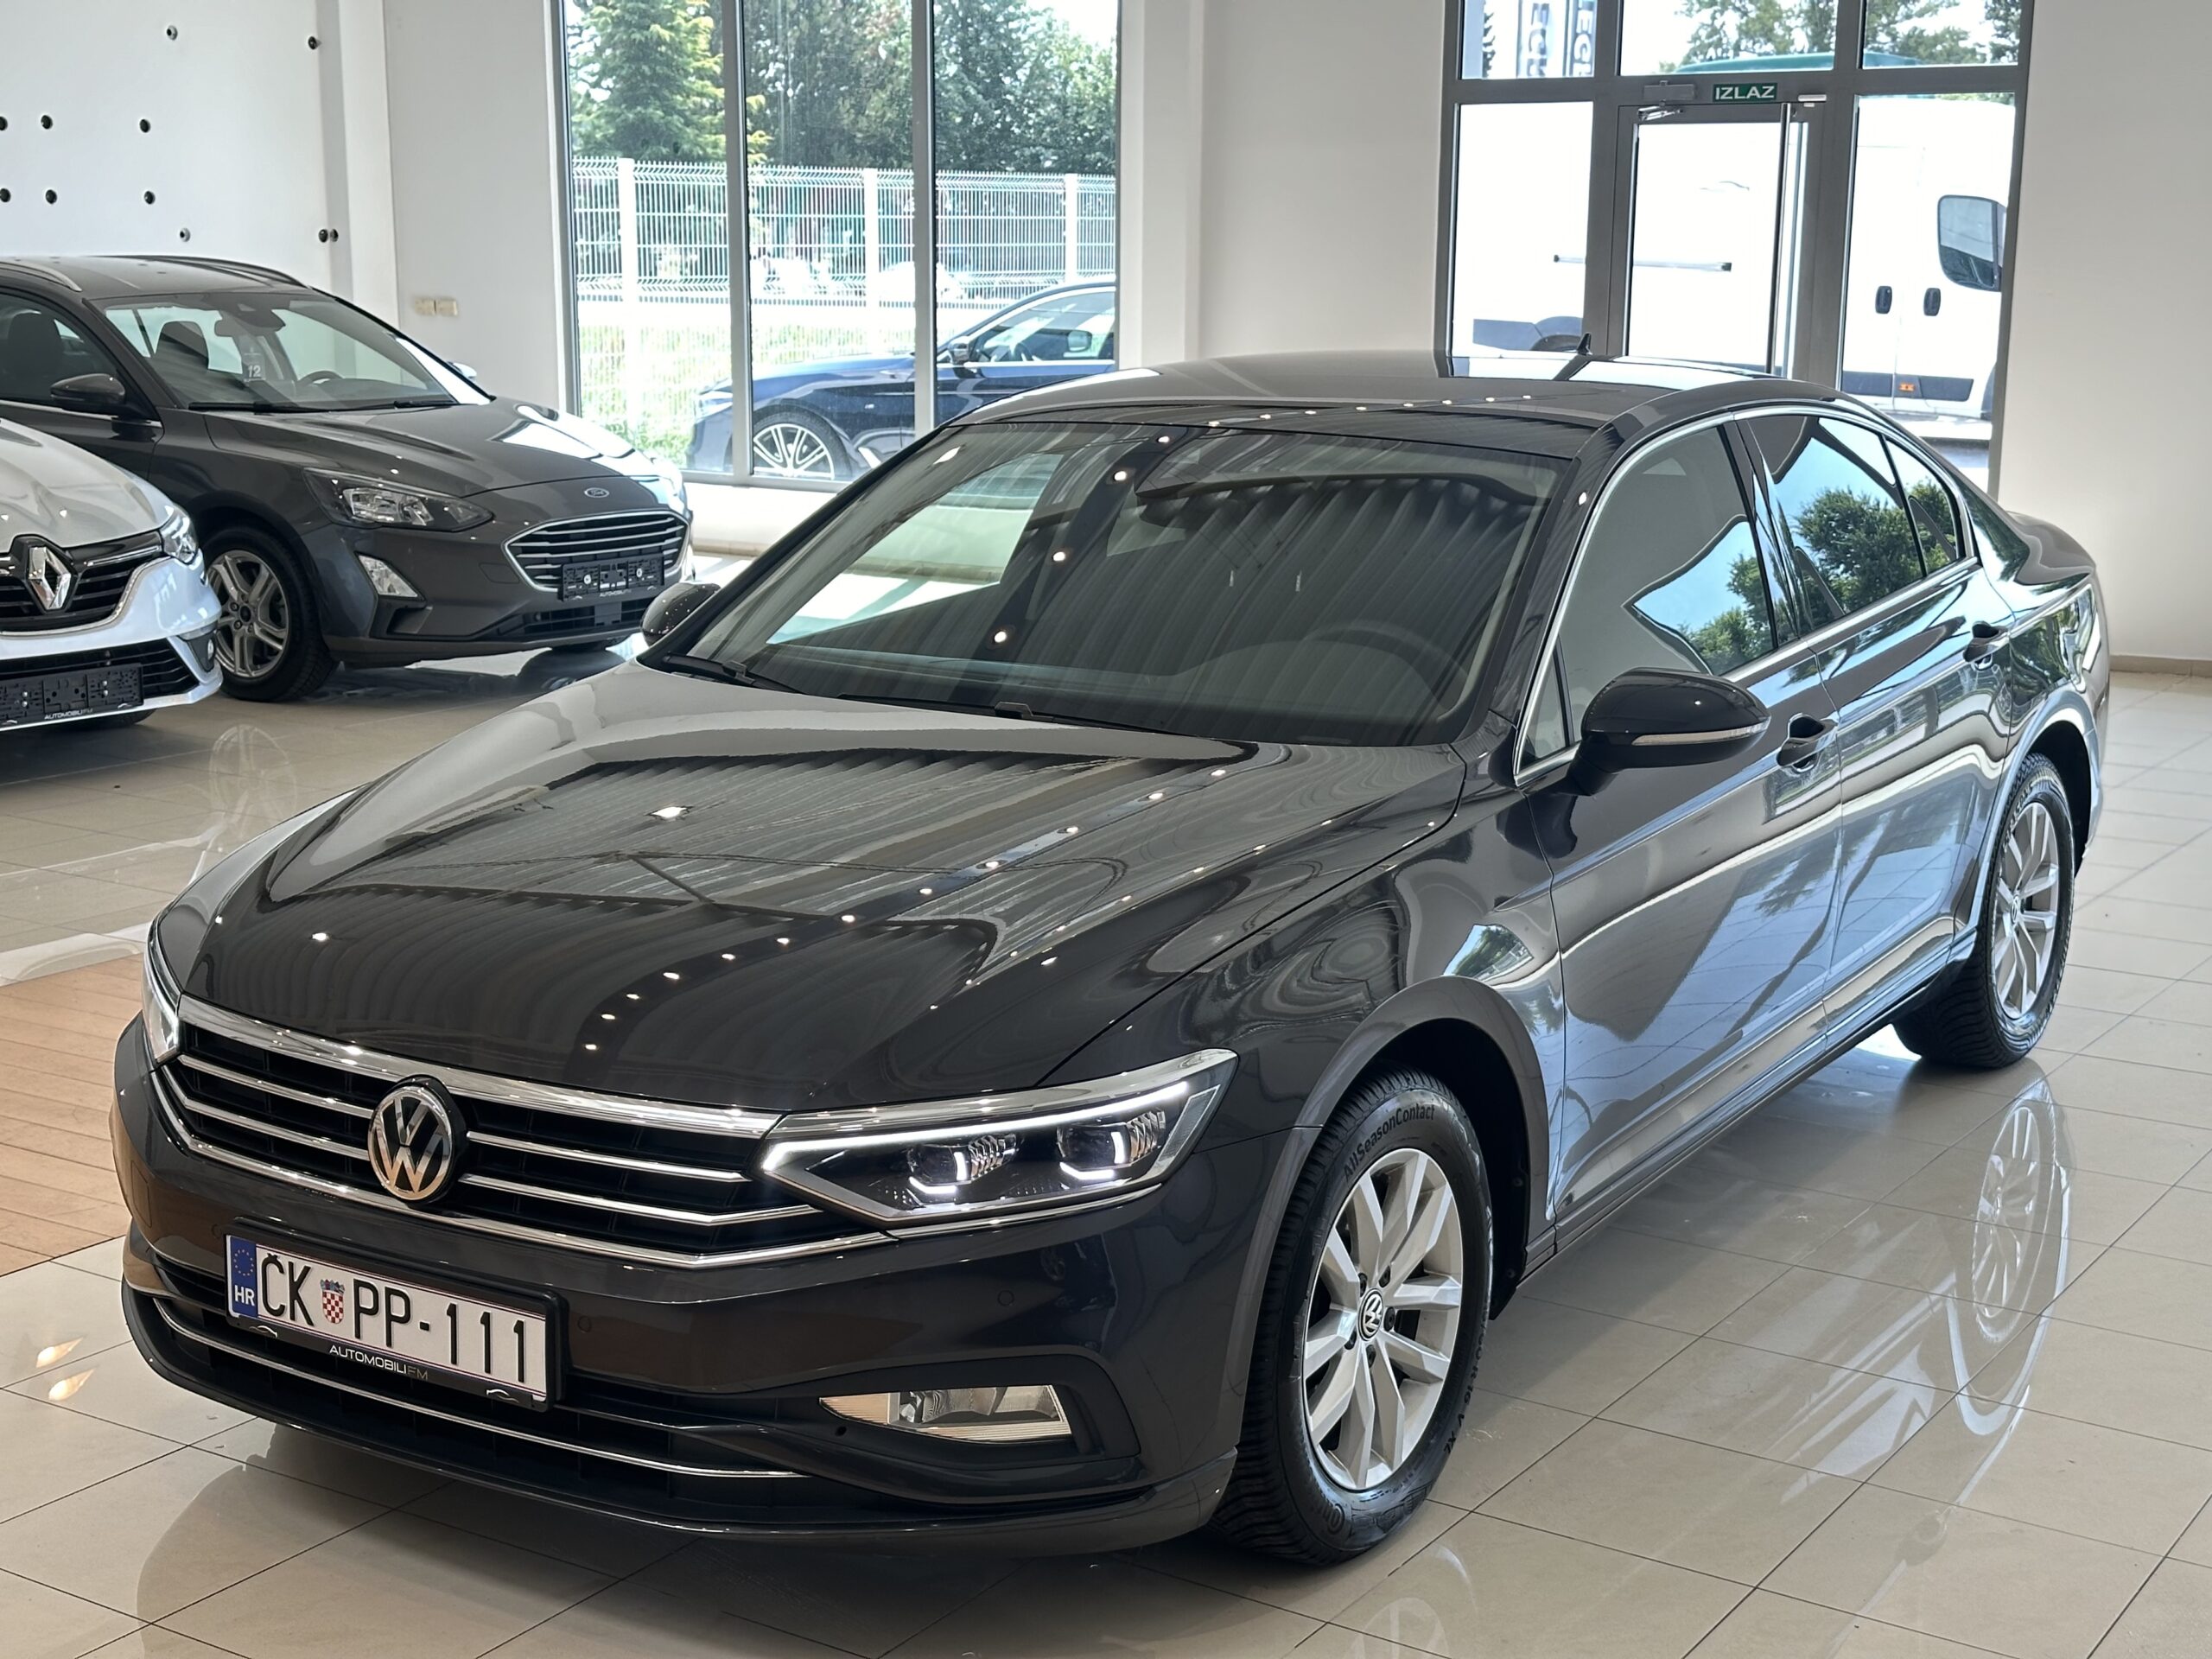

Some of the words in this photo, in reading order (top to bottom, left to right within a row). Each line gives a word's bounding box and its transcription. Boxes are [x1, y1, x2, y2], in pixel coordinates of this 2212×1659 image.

[1715, 86, 1775, 100] IZLAZ
[369, 1088, 451, 1199] VW
[1343, 1103, 1435, 1183] AllSeasonContact
[234, 1284, 256, 1306] HR
[261, 1253, 315, 1327] ČK
[353, 1278, 525, 1383] PP-111
